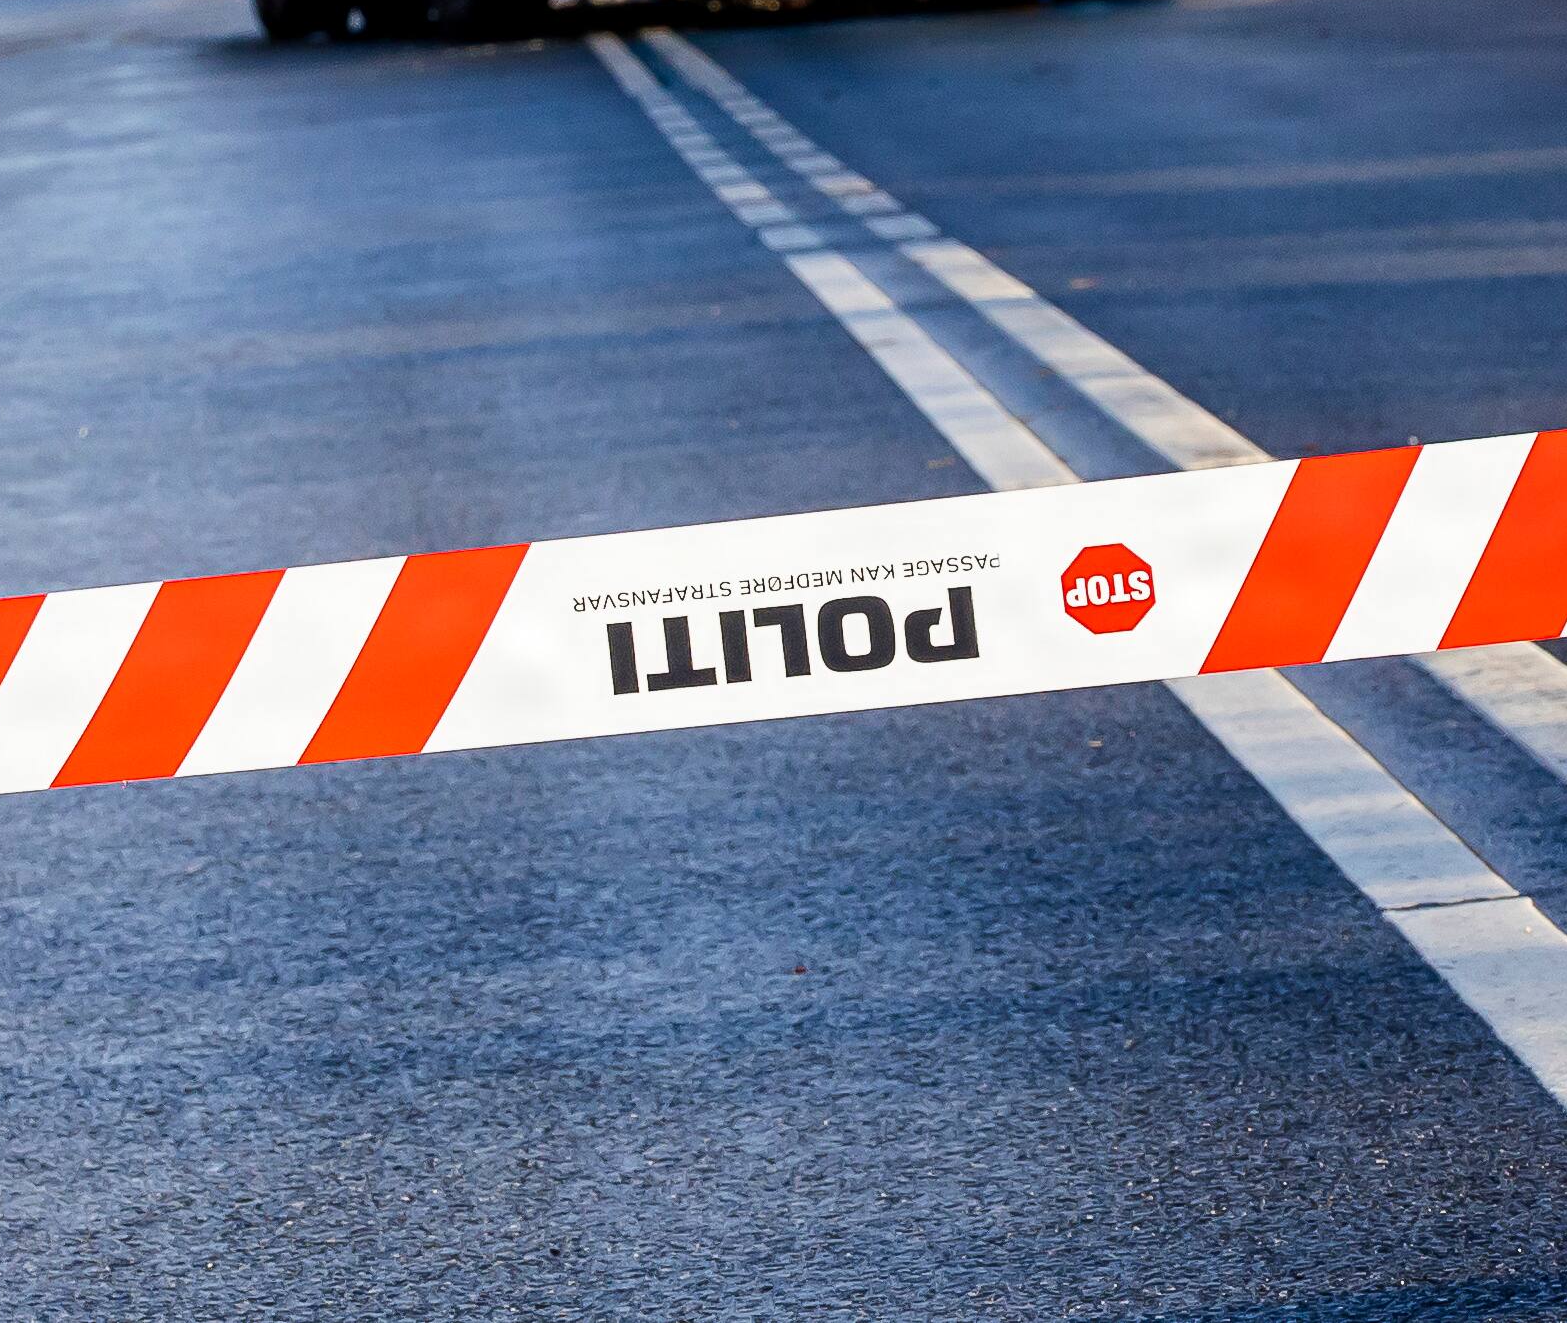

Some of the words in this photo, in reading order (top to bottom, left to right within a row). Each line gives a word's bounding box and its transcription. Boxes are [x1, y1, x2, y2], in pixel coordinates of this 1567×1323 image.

[850, 564, 896, 583] KAN
[902, 553, 1001, 578] PASSAGE
[572, 581, 732, 613] STRAFANSVAR
[738, 569, 843, 596] MEDFØRE
[1065, 570, 1151, 608] STOP
[606, 585, 980, 696] POLITI
